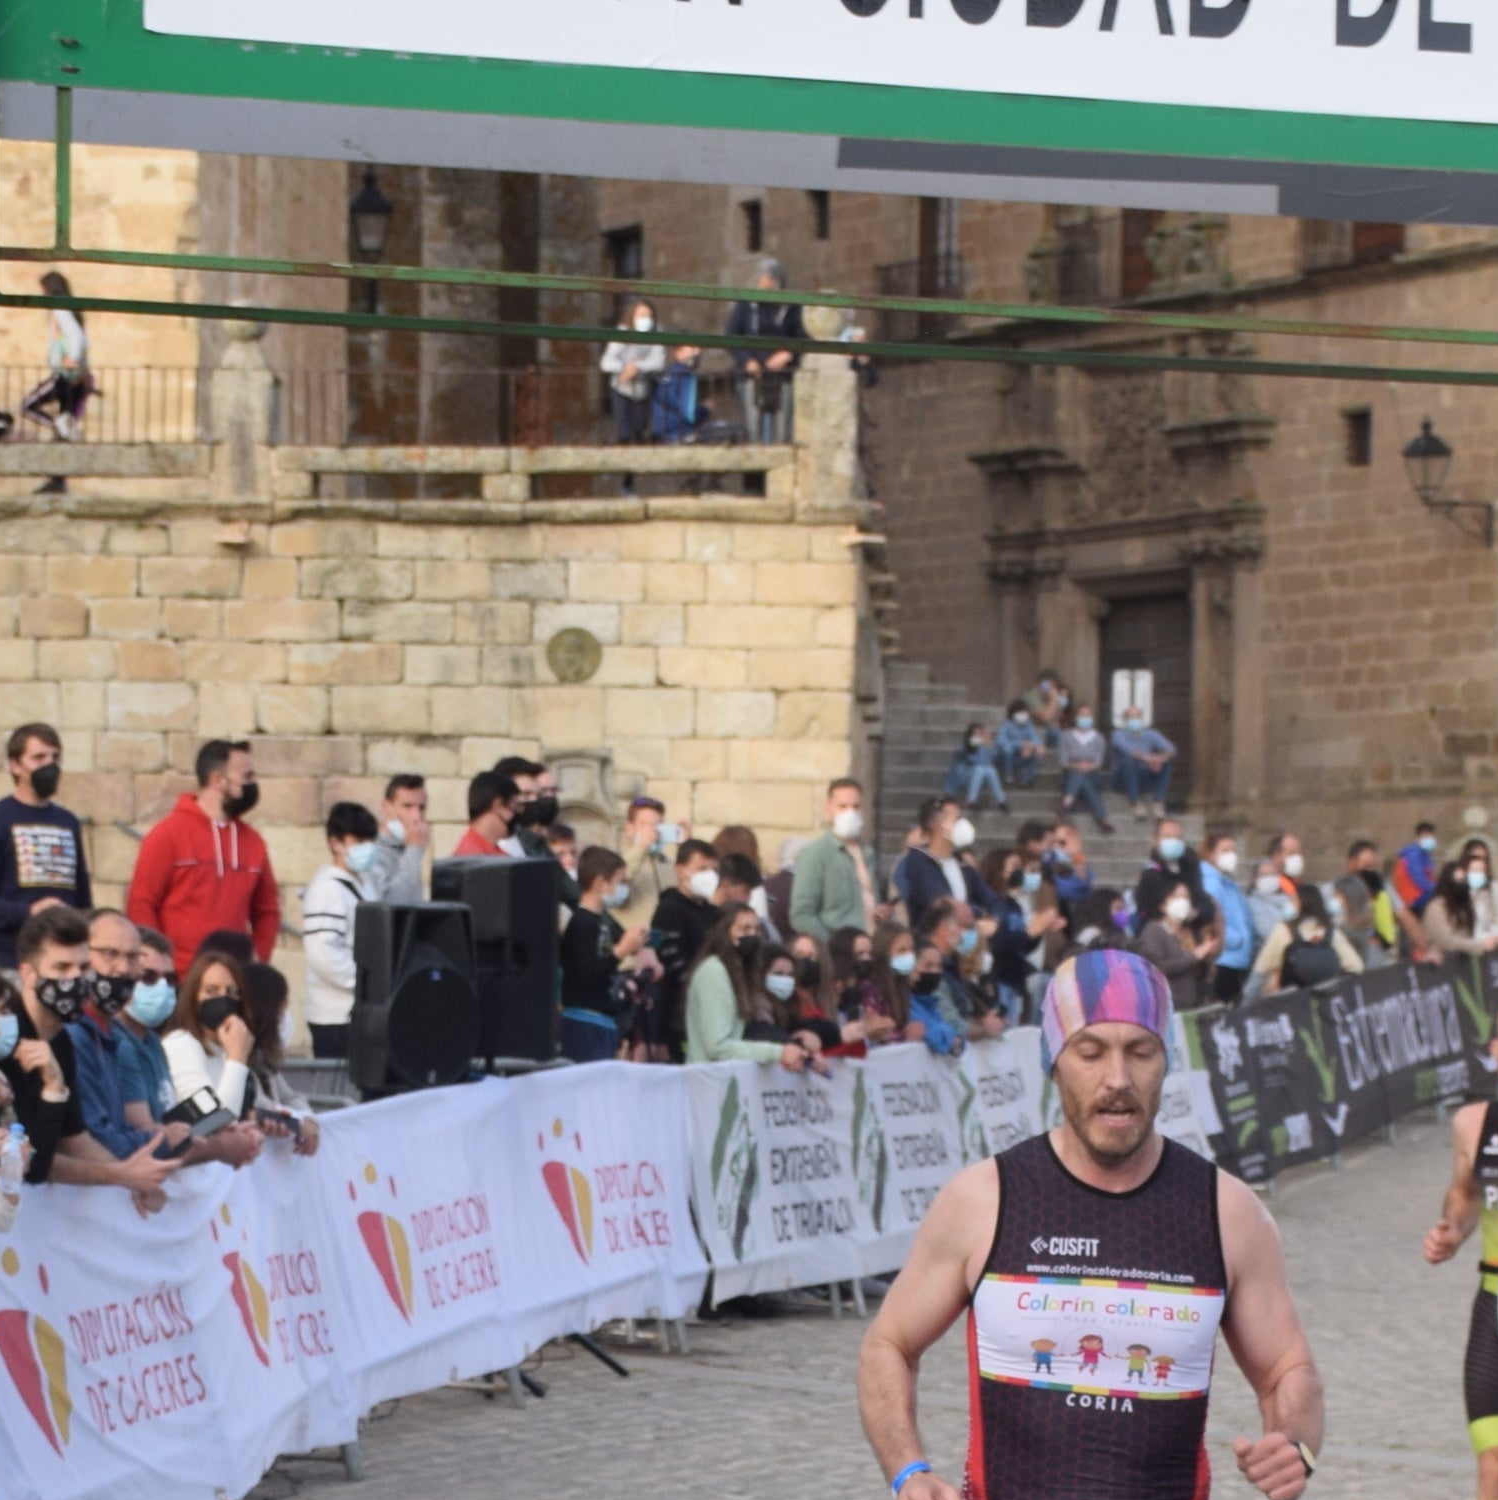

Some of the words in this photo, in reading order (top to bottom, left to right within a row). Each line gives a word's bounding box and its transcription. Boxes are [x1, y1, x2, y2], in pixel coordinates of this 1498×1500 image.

[1049, 1236, 1100, 1257] CUSFIT
[1026, 1264, 1195, 1284] www.colorincoloradocoria.com
[1105, 1298, 1200, 1323] colorado
[69, 1280, 194, 1366] DIPUTACIÓN
[87, 1379, 117, 1433] DE
[117, 1356, 207, 1426] CÁCERES
[1066, 1393, 1134, 1413] CORIA
